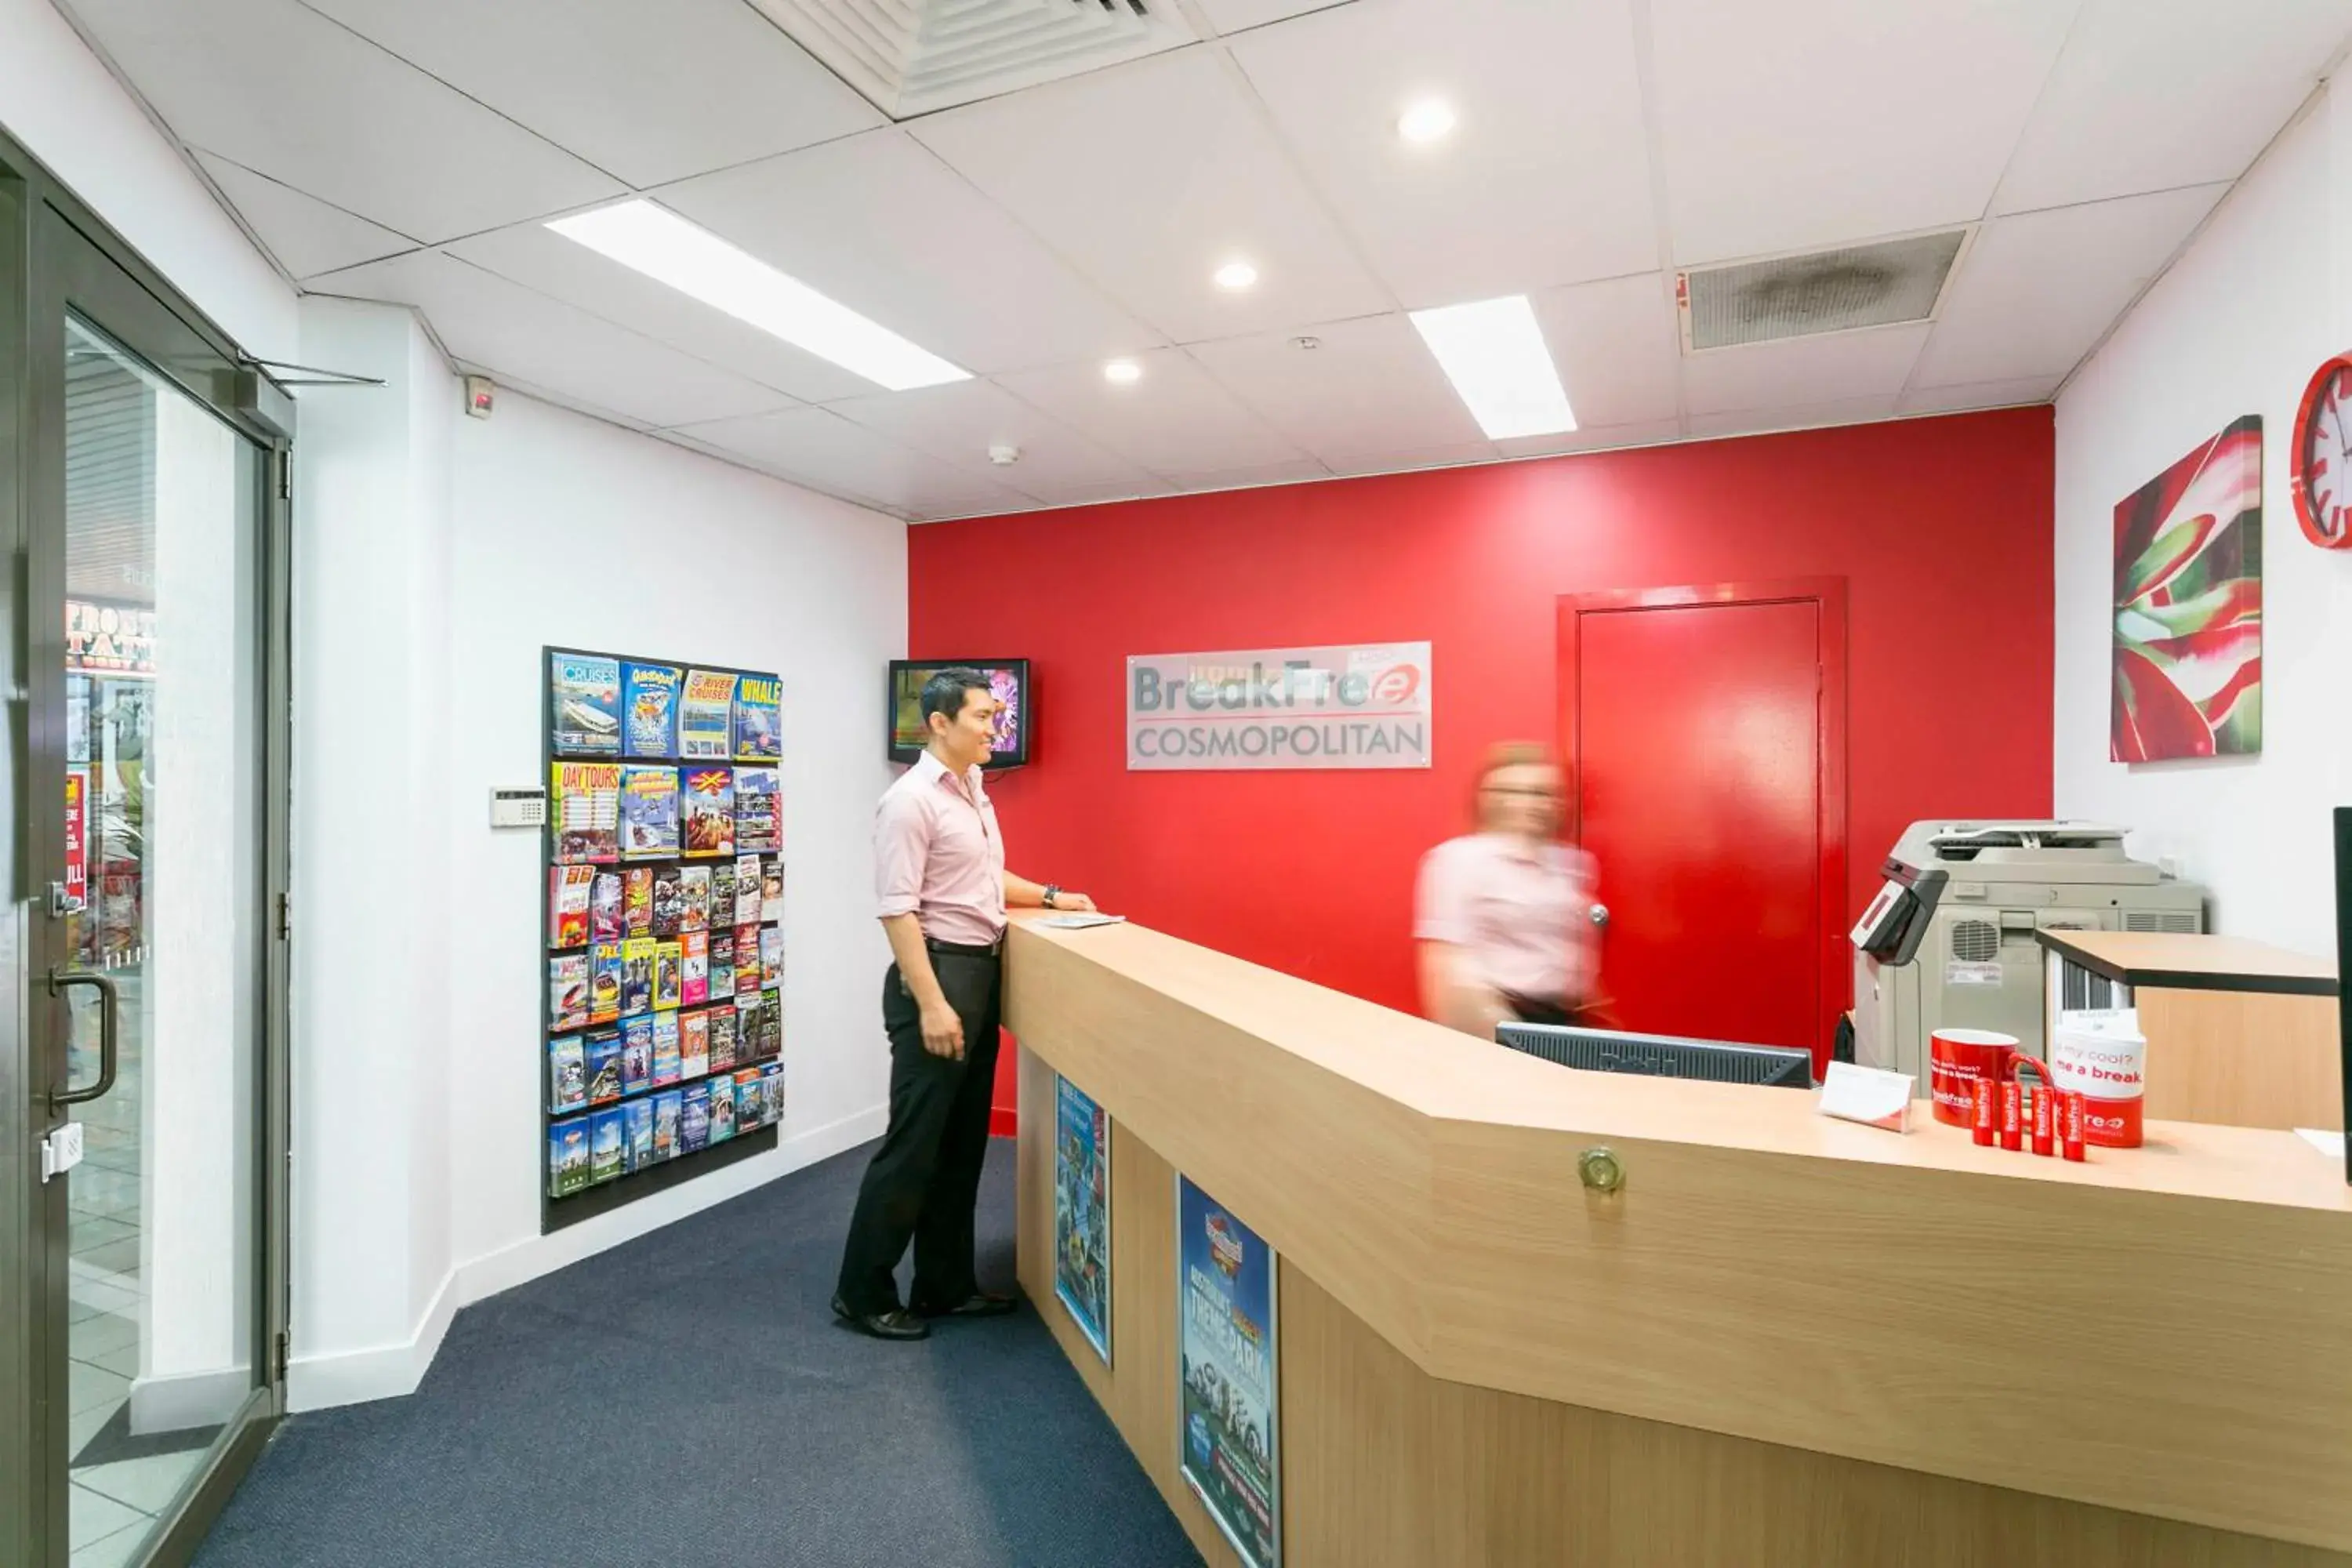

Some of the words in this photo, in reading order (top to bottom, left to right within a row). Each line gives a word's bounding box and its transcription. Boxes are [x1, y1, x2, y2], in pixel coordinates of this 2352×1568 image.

[564, 666, 615, 684] CRUISES
[704, 677, 734, 688] RIVER
[689, 687, 730, 701] CRUISES
[741, 677, 782, 705] WHALE
[1134, 660, 1421, 711] BreakFree
[1135, 723, 1423, 758] COSMOPOLITAN
[562, 765, 581, 788] DAY
[583, 765, 619, 789] TOURS
[2088, 1051, 2133, 1065] cool?
[2078, 1065, 2086, 1076] a
